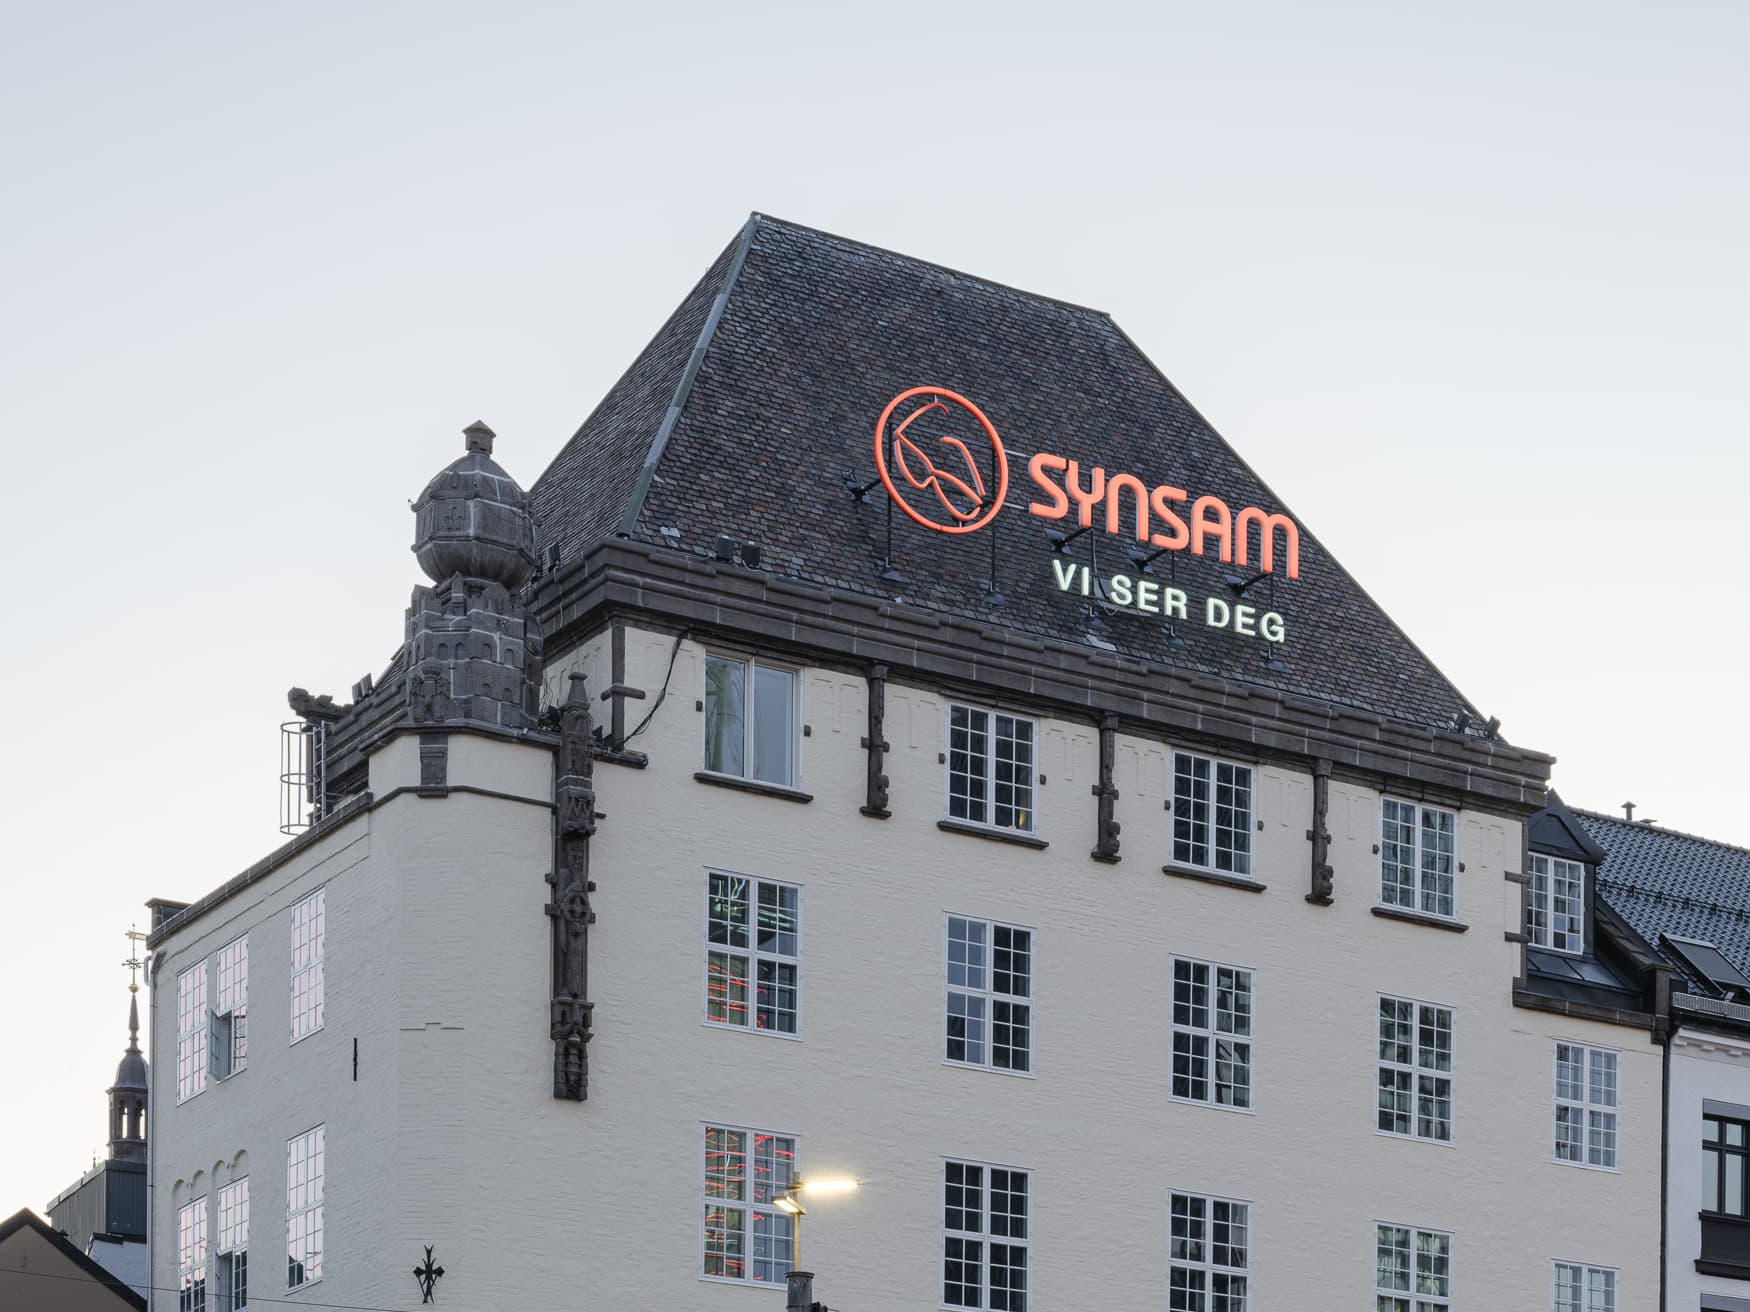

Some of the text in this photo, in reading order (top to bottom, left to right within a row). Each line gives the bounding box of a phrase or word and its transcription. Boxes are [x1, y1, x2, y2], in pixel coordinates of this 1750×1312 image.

[1028, 452, 1299, 580] SYNSAM
[1053, 559, 1285, 643] VI SER DEG
